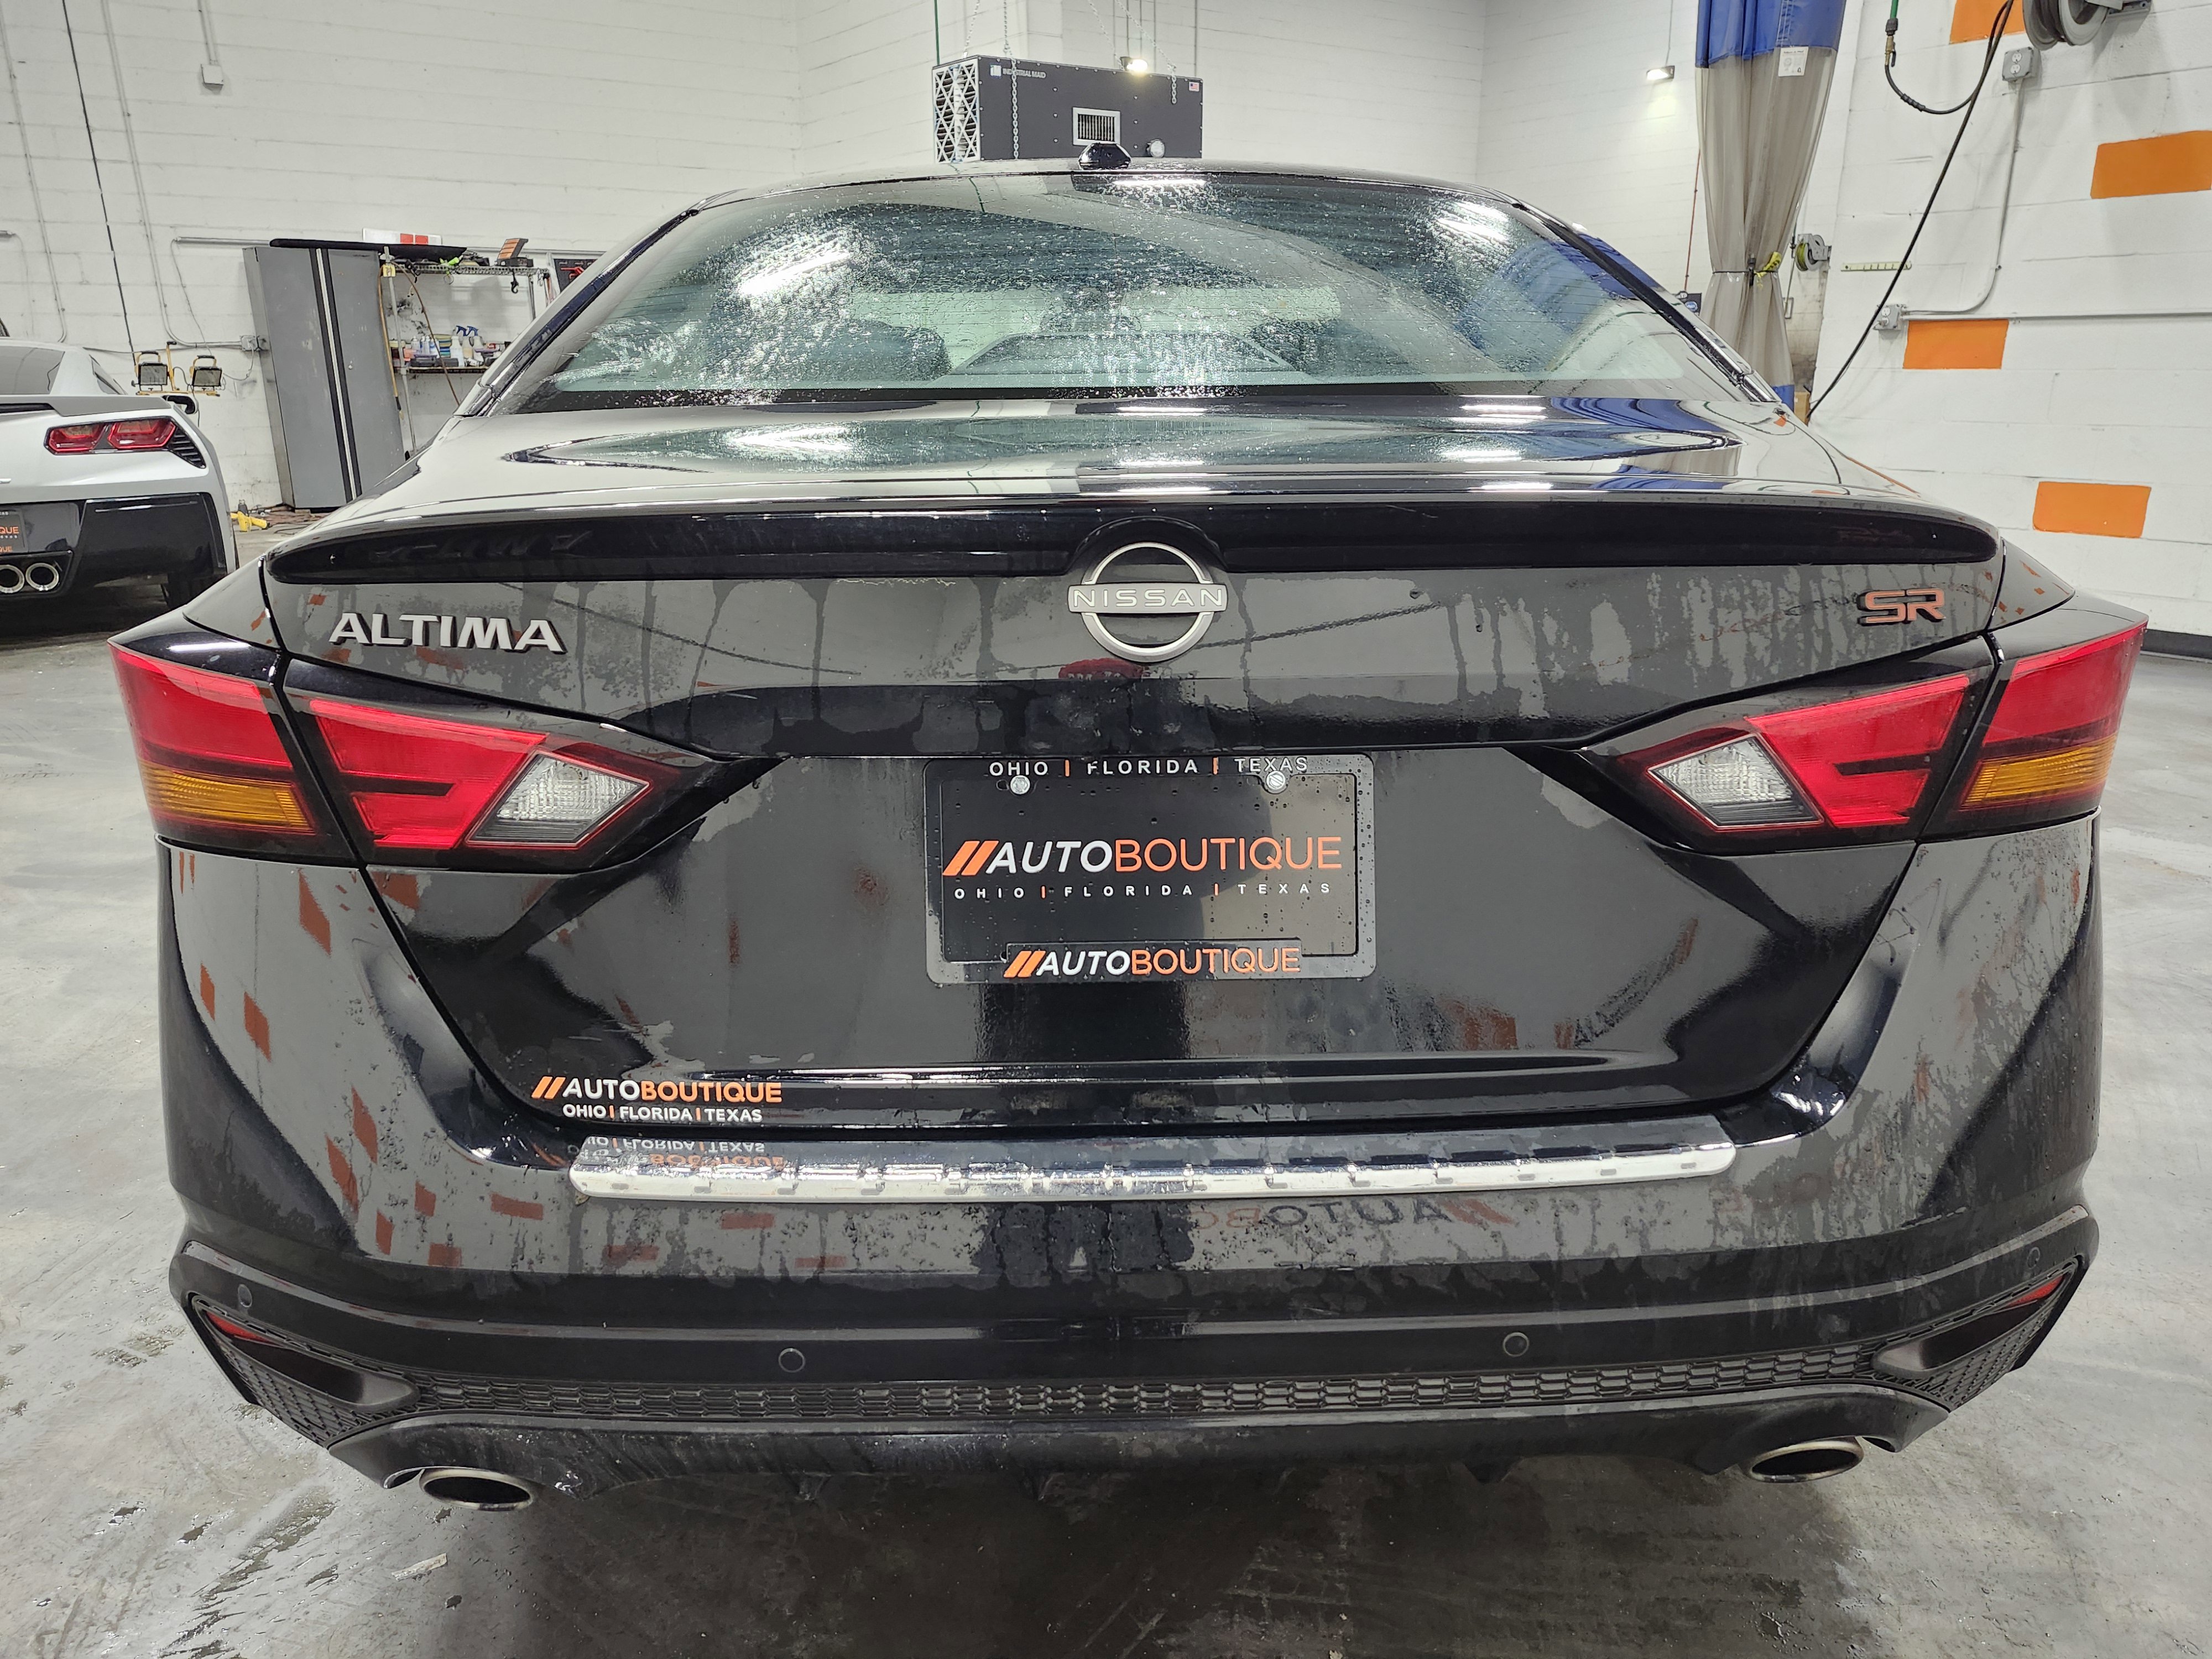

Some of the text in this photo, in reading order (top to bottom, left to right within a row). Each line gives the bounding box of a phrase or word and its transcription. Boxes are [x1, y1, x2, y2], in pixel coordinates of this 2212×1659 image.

[1073, 589, 1222, 607] NISSAN
[1865, 588, 1946, 623] SR
[328, 612, 567, 654] ALTIMA
[989, 757, 1308, 776] OHIO FLORIDA TEXAS
[954, 883, 1330, 900] OHIO FLORIDA TEXAS
[562, 1103, 763, 1122] OHIO FLORIDA TEXAS
